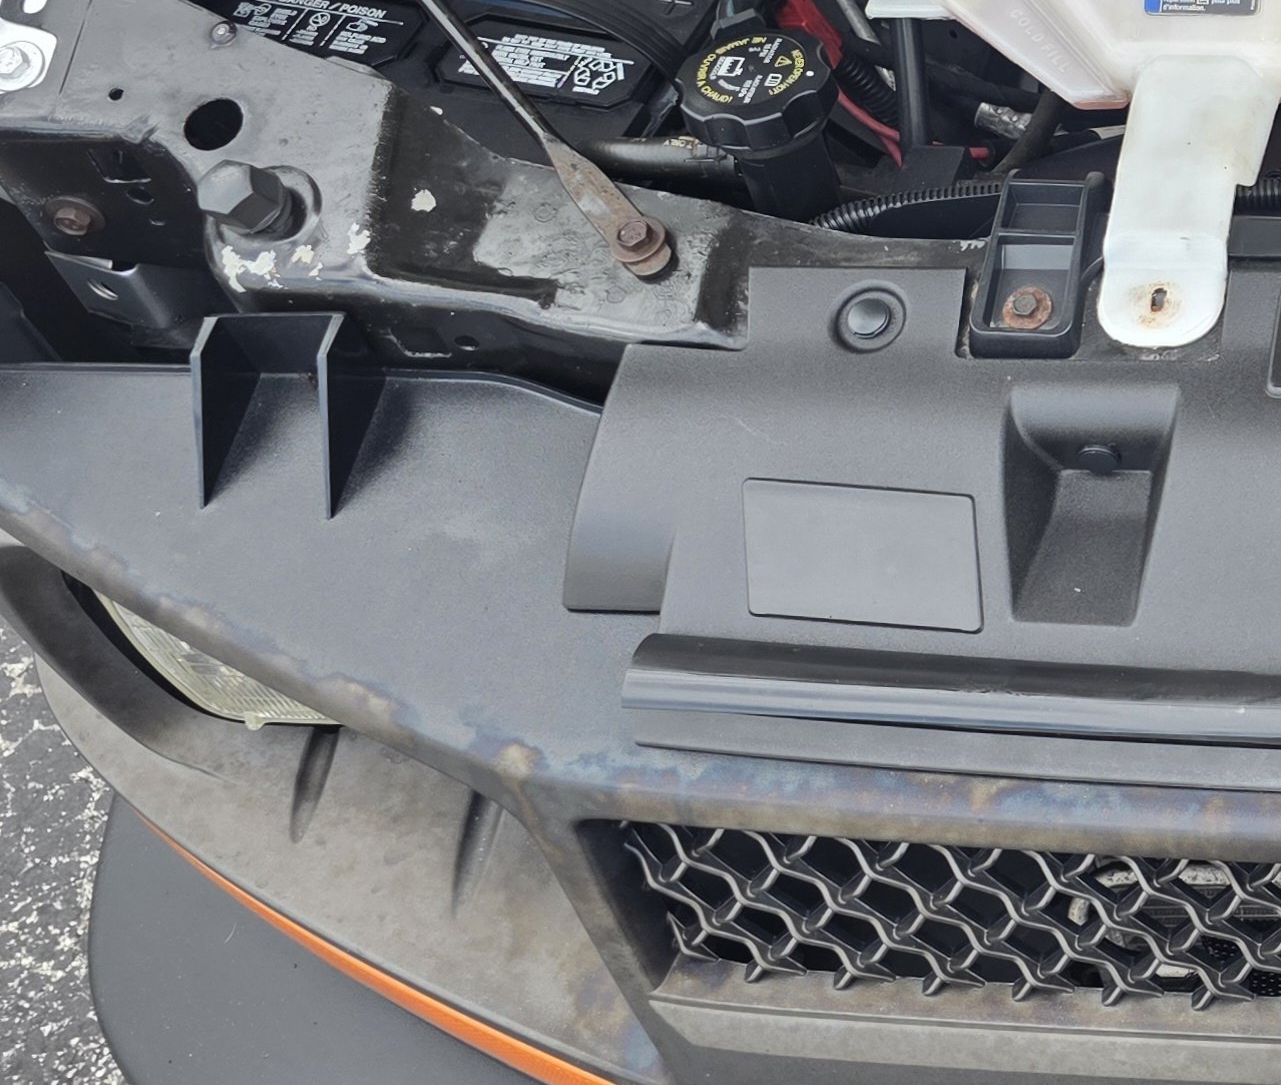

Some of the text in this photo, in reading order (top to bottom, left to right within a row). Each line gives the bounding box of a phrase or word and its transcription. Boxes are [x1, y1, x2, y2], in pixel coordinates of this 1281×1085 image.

[340, 3, 387, 19] POISON
[715, 38, 750, 55] JAMAIS
[1011, 8, 1069, 72] COLD FILL
[791, 49, 805, 66] NEVER
[789, 66, 803, 84] OPEN
[701, 85, 734, 104] CHAUD!
